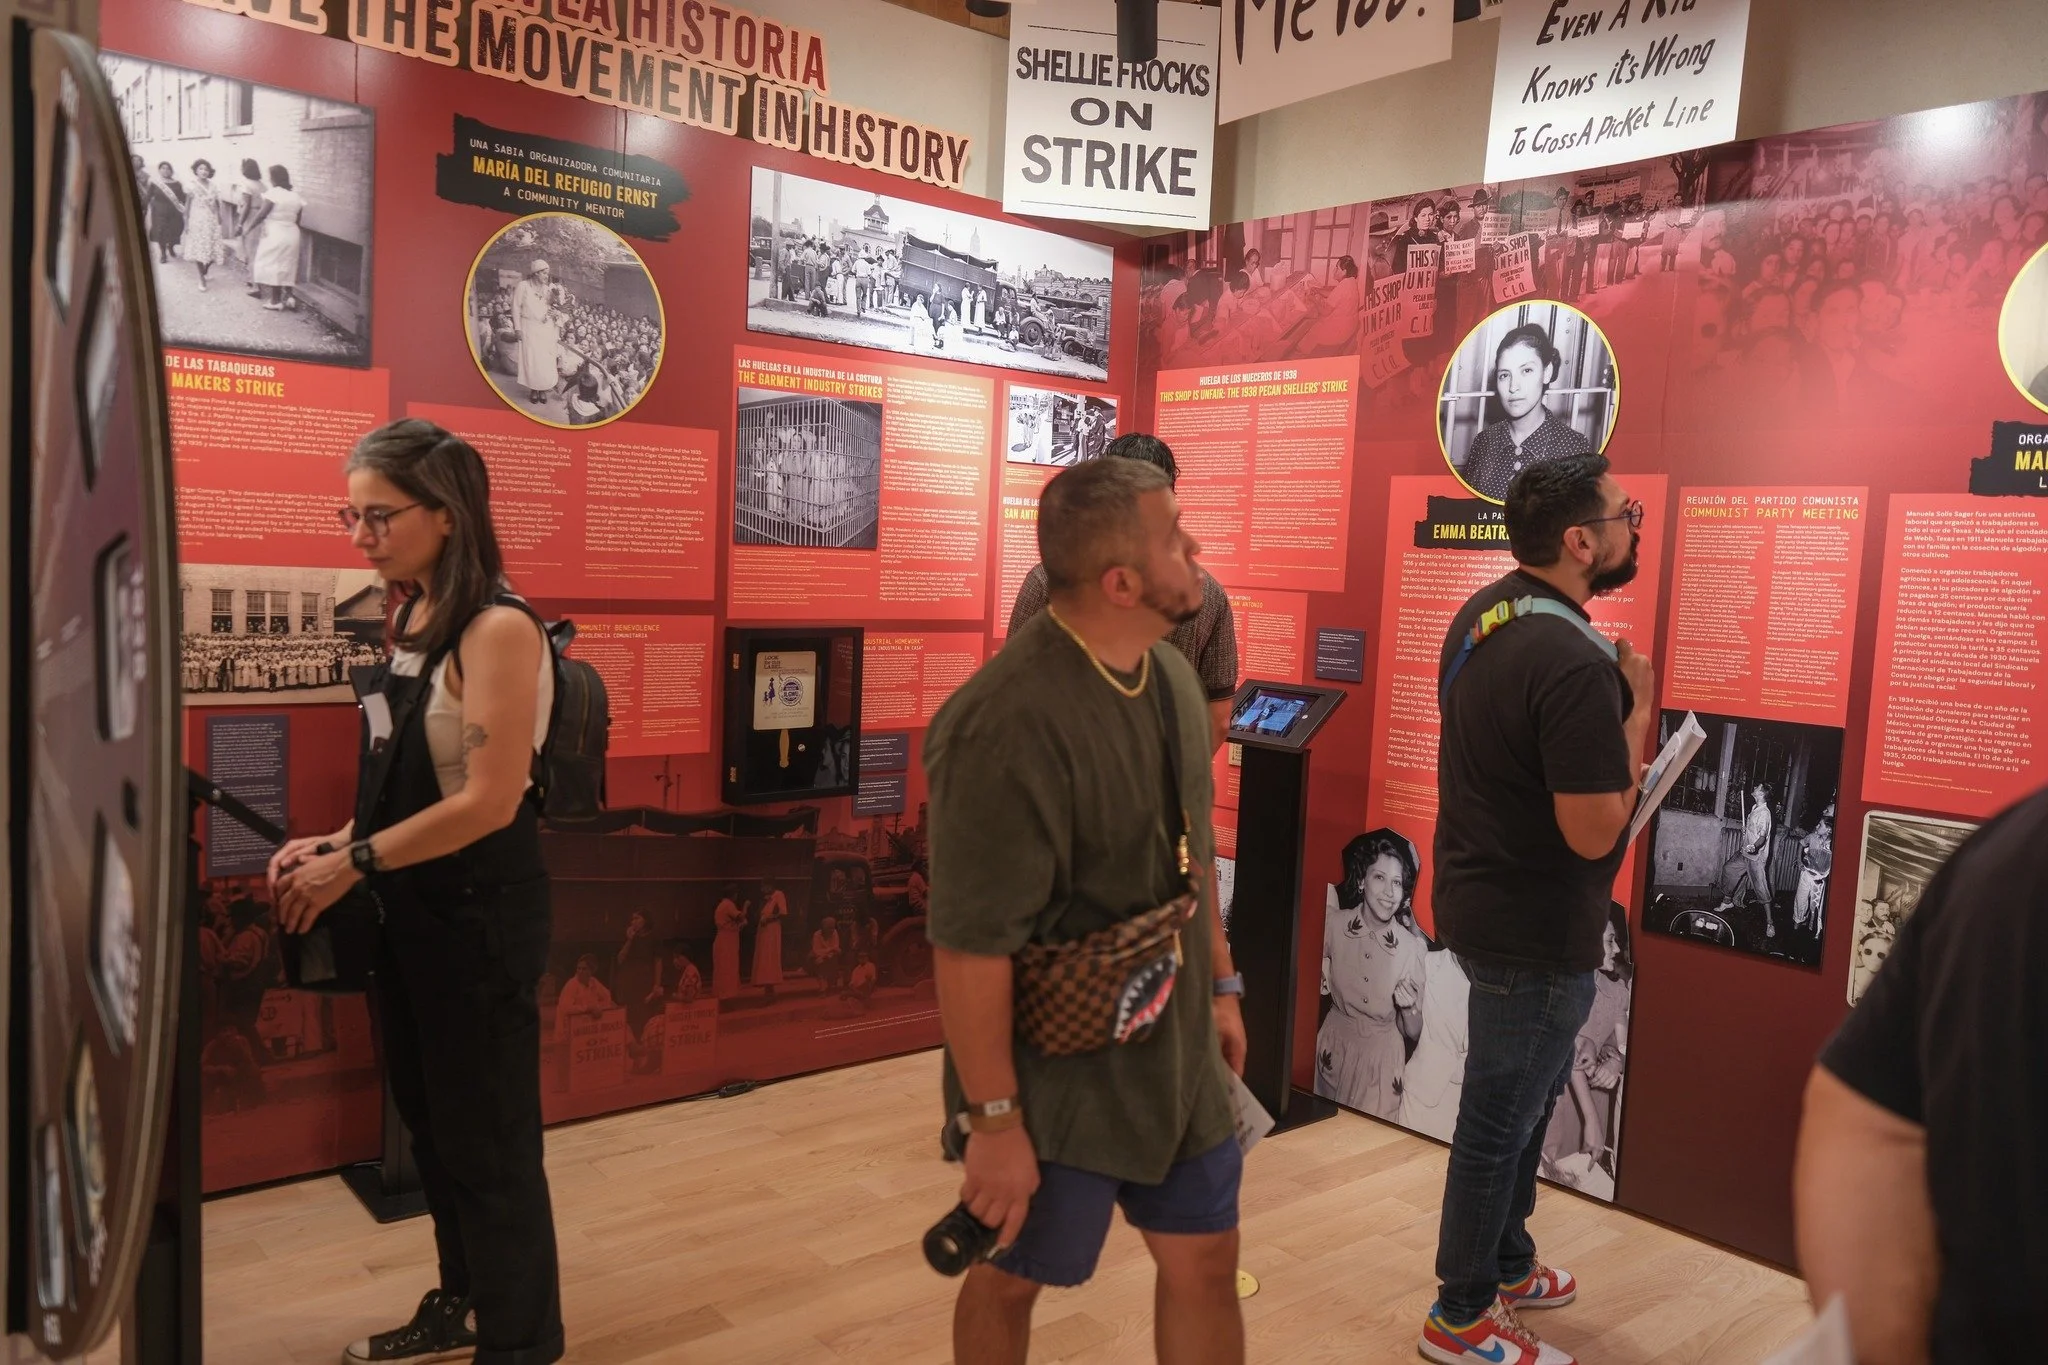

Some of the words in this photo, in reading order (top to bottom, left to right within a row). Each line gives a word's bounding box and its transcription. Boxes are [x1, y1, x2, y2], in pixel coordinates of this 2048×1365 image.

[633, 0, 827, 91] HISTORIA
[1016, 46, 1113, 87] SHELLIE
[1116, 59, 1210, 97] FROCKS
[1522, 65, 1597, 103] Knows
[1641, 34, 1716, 79] Wrong
[477, 9, 740, 128] MOVEMENT
[757, 83, 798, 144] IN
[813, 103, 969, 185] HISTORY
[1070, 97, 1153, 131] ON
[1509, 127, 1527, 156] To
[1576, 117, 1594, 146] A
[1663, 97, 1714, 127] Line
[470, 139, 488, 150] UNA
[494, 143, 524, 157] SABIA
[530, 151, 597, 173] ORGANIZADORA
[603, 167, 661, 186] COMUNITARIA
[1021, 134, 1198, 197] STRIKE
[473, 156, 520, 181] MARÍA
[525, 169, 550, 187] DEL
[556, 173, 611, 200] REFUGIO
[617, 185, 657, 209] ERNST
[503, 187, 511, 196] A
[518, 189, 579, 210] COMMUNITY
[586, 203, 624, 219] MENTOR
[165, 355, 181, 368] DE
[184, 358, 203, 370] LAS
[207, 360, 275, 377] TABAQUERAS
[738, 359, 750, 368] LAS
[753, 361, 781, 372] HUELGAS
[783, 364, 791, 373] EN
[794, 366, 801, 375] LA
[803, 367, 835, 378] INDUSTRIA
[838, 371, 845, 380] DE
[847, 373, 854, 381] LA
[856, 373, 882, 384] COSTURA
[1200, 375, 1220, 386] HUELGA
[1231, 375, 1241, 383] LOS
[1274, 371, 1281, 380] DE
[1283, 370, 1297, 379] 1938
[172, 372, 231, 393] MAKERS
[235, 379, 284, 397] STRIKE
[738, 370, 755, 383] THE
[759, 373, 801, 388] GARMENT
[804, 379, 846, 394] INDUSTRY
[849, 384, 883, 398] STRIKES
[1160, 391, 1173, 402] THIS
[1175, 391, 1192, 401] SHOP
[1193, 390, 1199, 400] IS
[1227, 388, 1240, 398] THE
[1242, 387, 1257, 397] 1938
[1259, 385, 1281, 397] PECAN
[1322, 380, 1348, 392] STRIKE
[1004, 507, 1018, 519] SAN
[1684, 508, 1748, 518] COMMUNIST
[1757, 508, 1795, 518] PARTY
[1803, 508, 1859, 520] MEETING
[1687, 495, 1726, 505] REUNIÓN
[1732, 496, 1748, 505] DEL
[1754, 496, 1797, 505] PARTIDO
[1803, 496, 1859, 505] COMUNISTA
[1478, 512, 1487, 520] LA
[1433, 524, 1466, 539] EMMA
